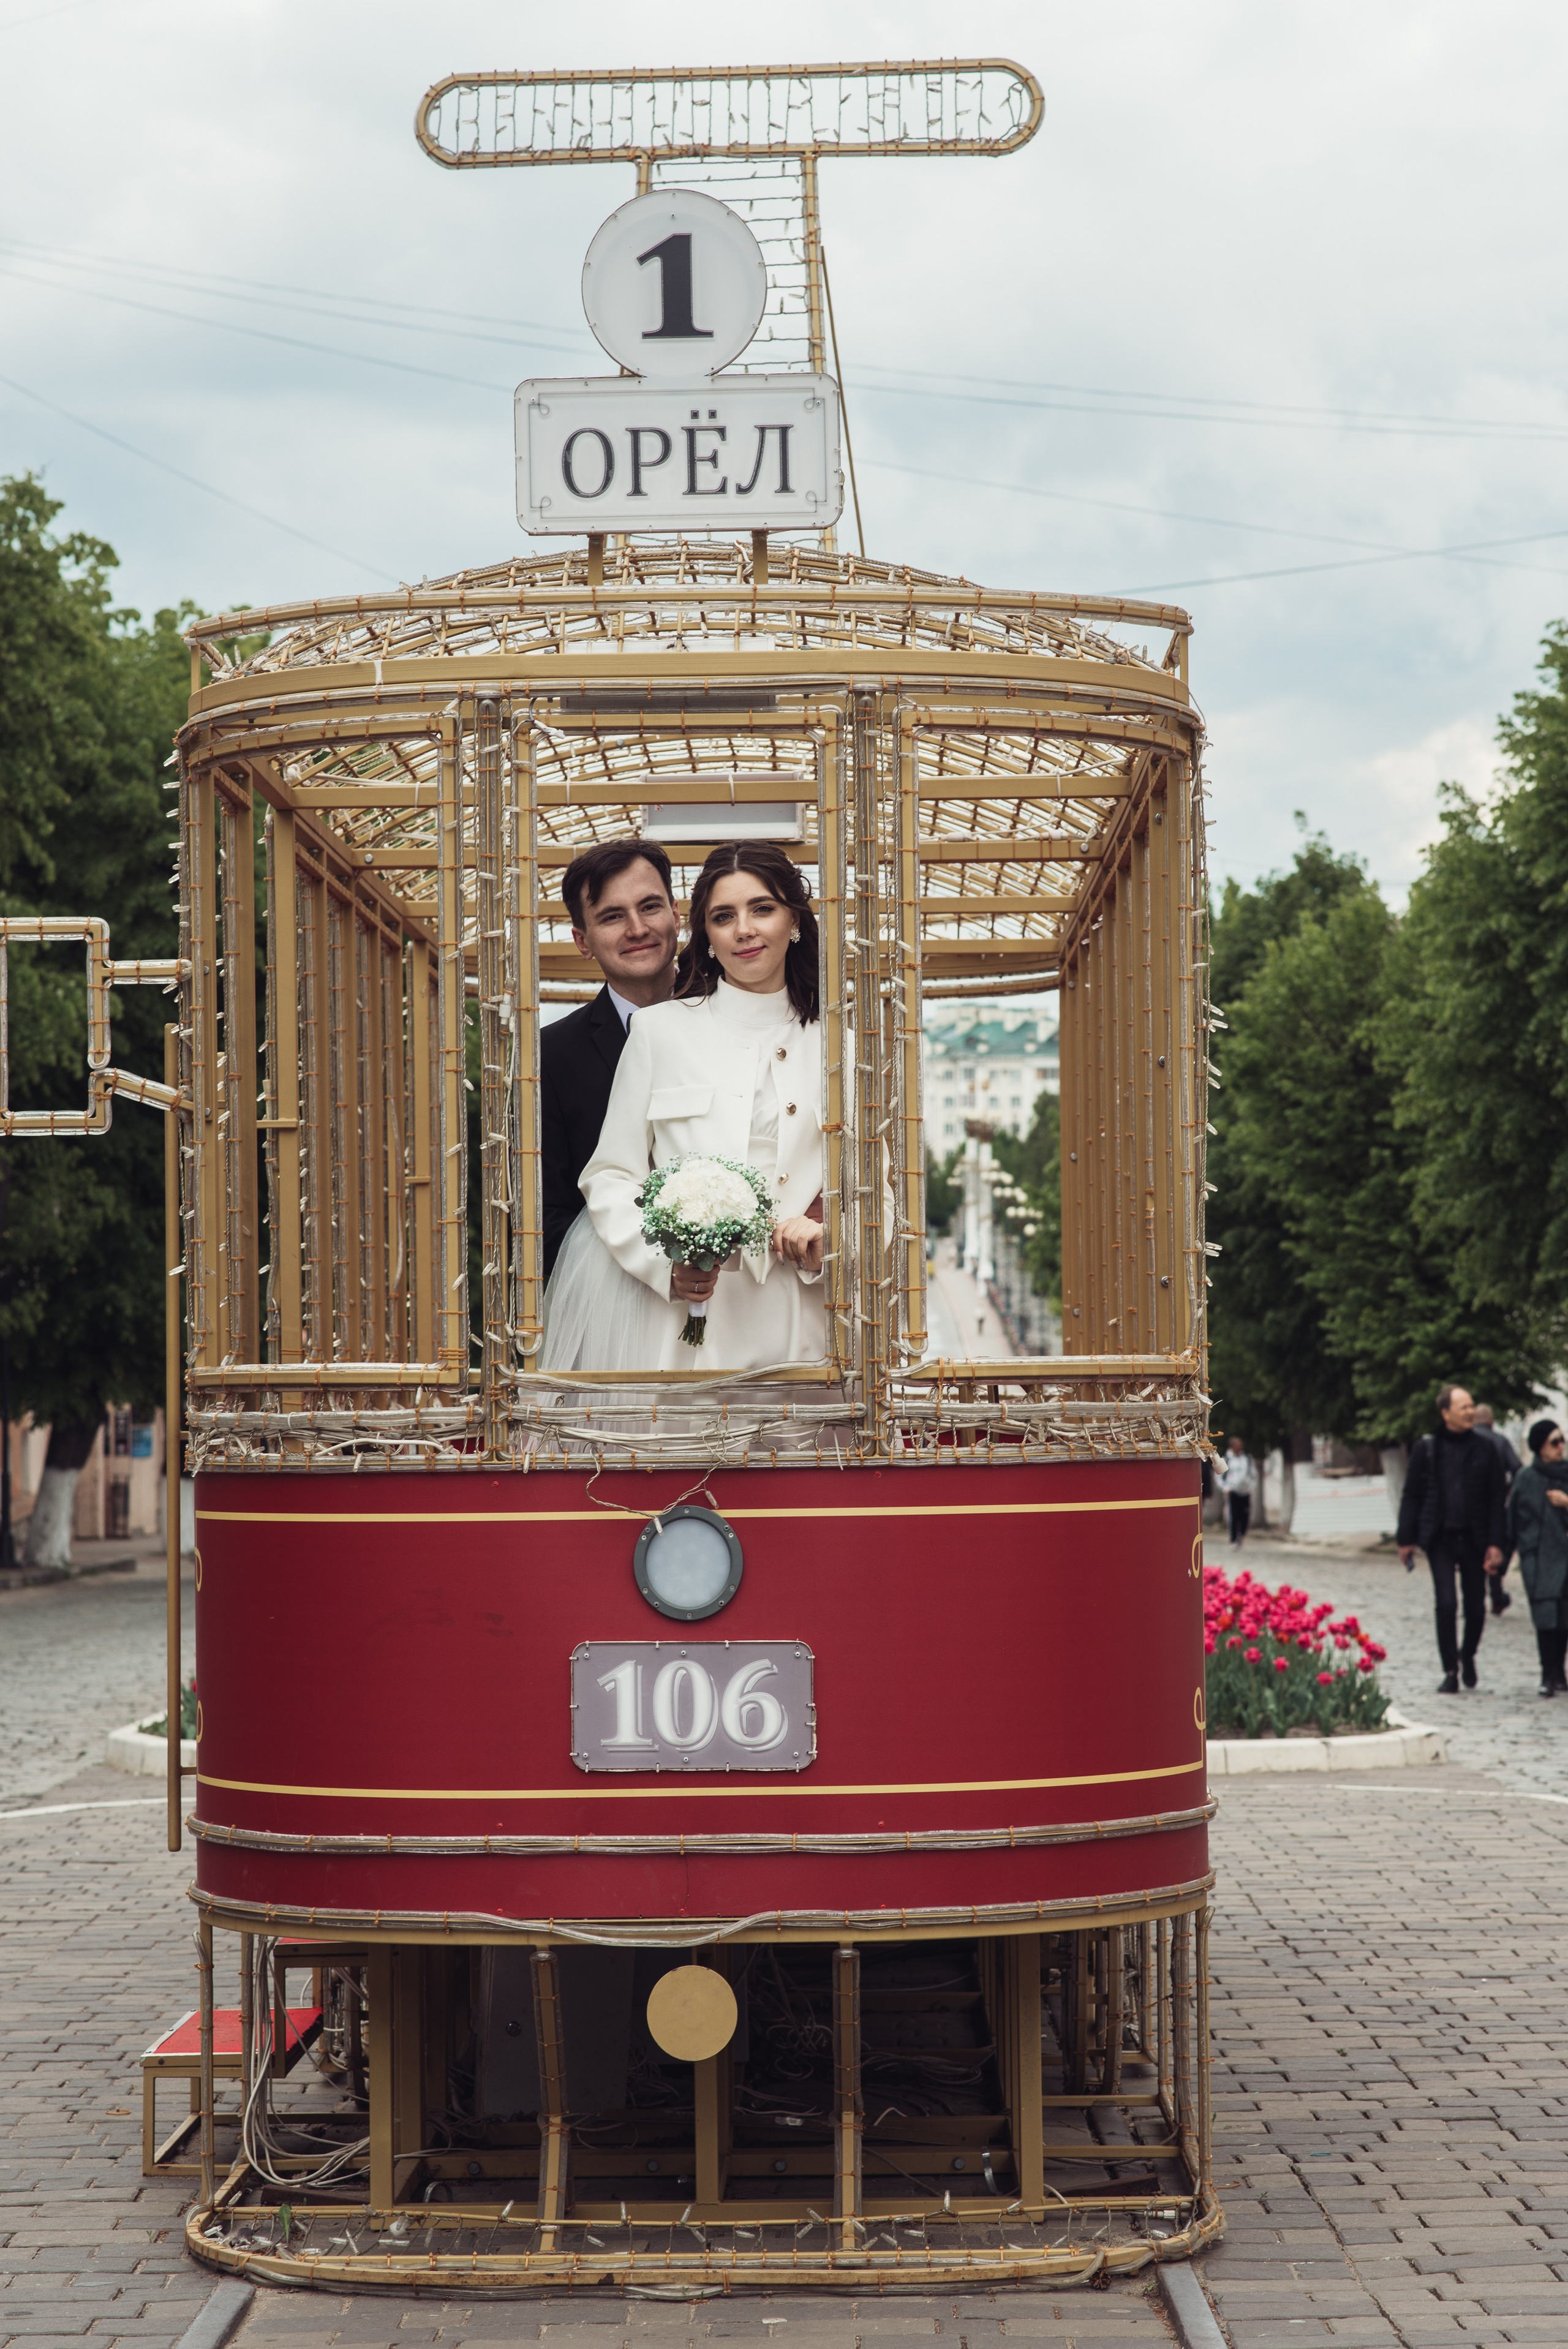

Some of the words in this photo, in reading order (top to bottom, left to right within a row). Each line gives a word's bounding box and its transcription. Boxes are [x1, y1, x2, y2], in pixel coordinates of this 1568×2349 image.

[636, 233, 714, 339] 1
[562, 410, 794, 498] ОРЁЛ
[597, 1659, 788, 1752] 106
